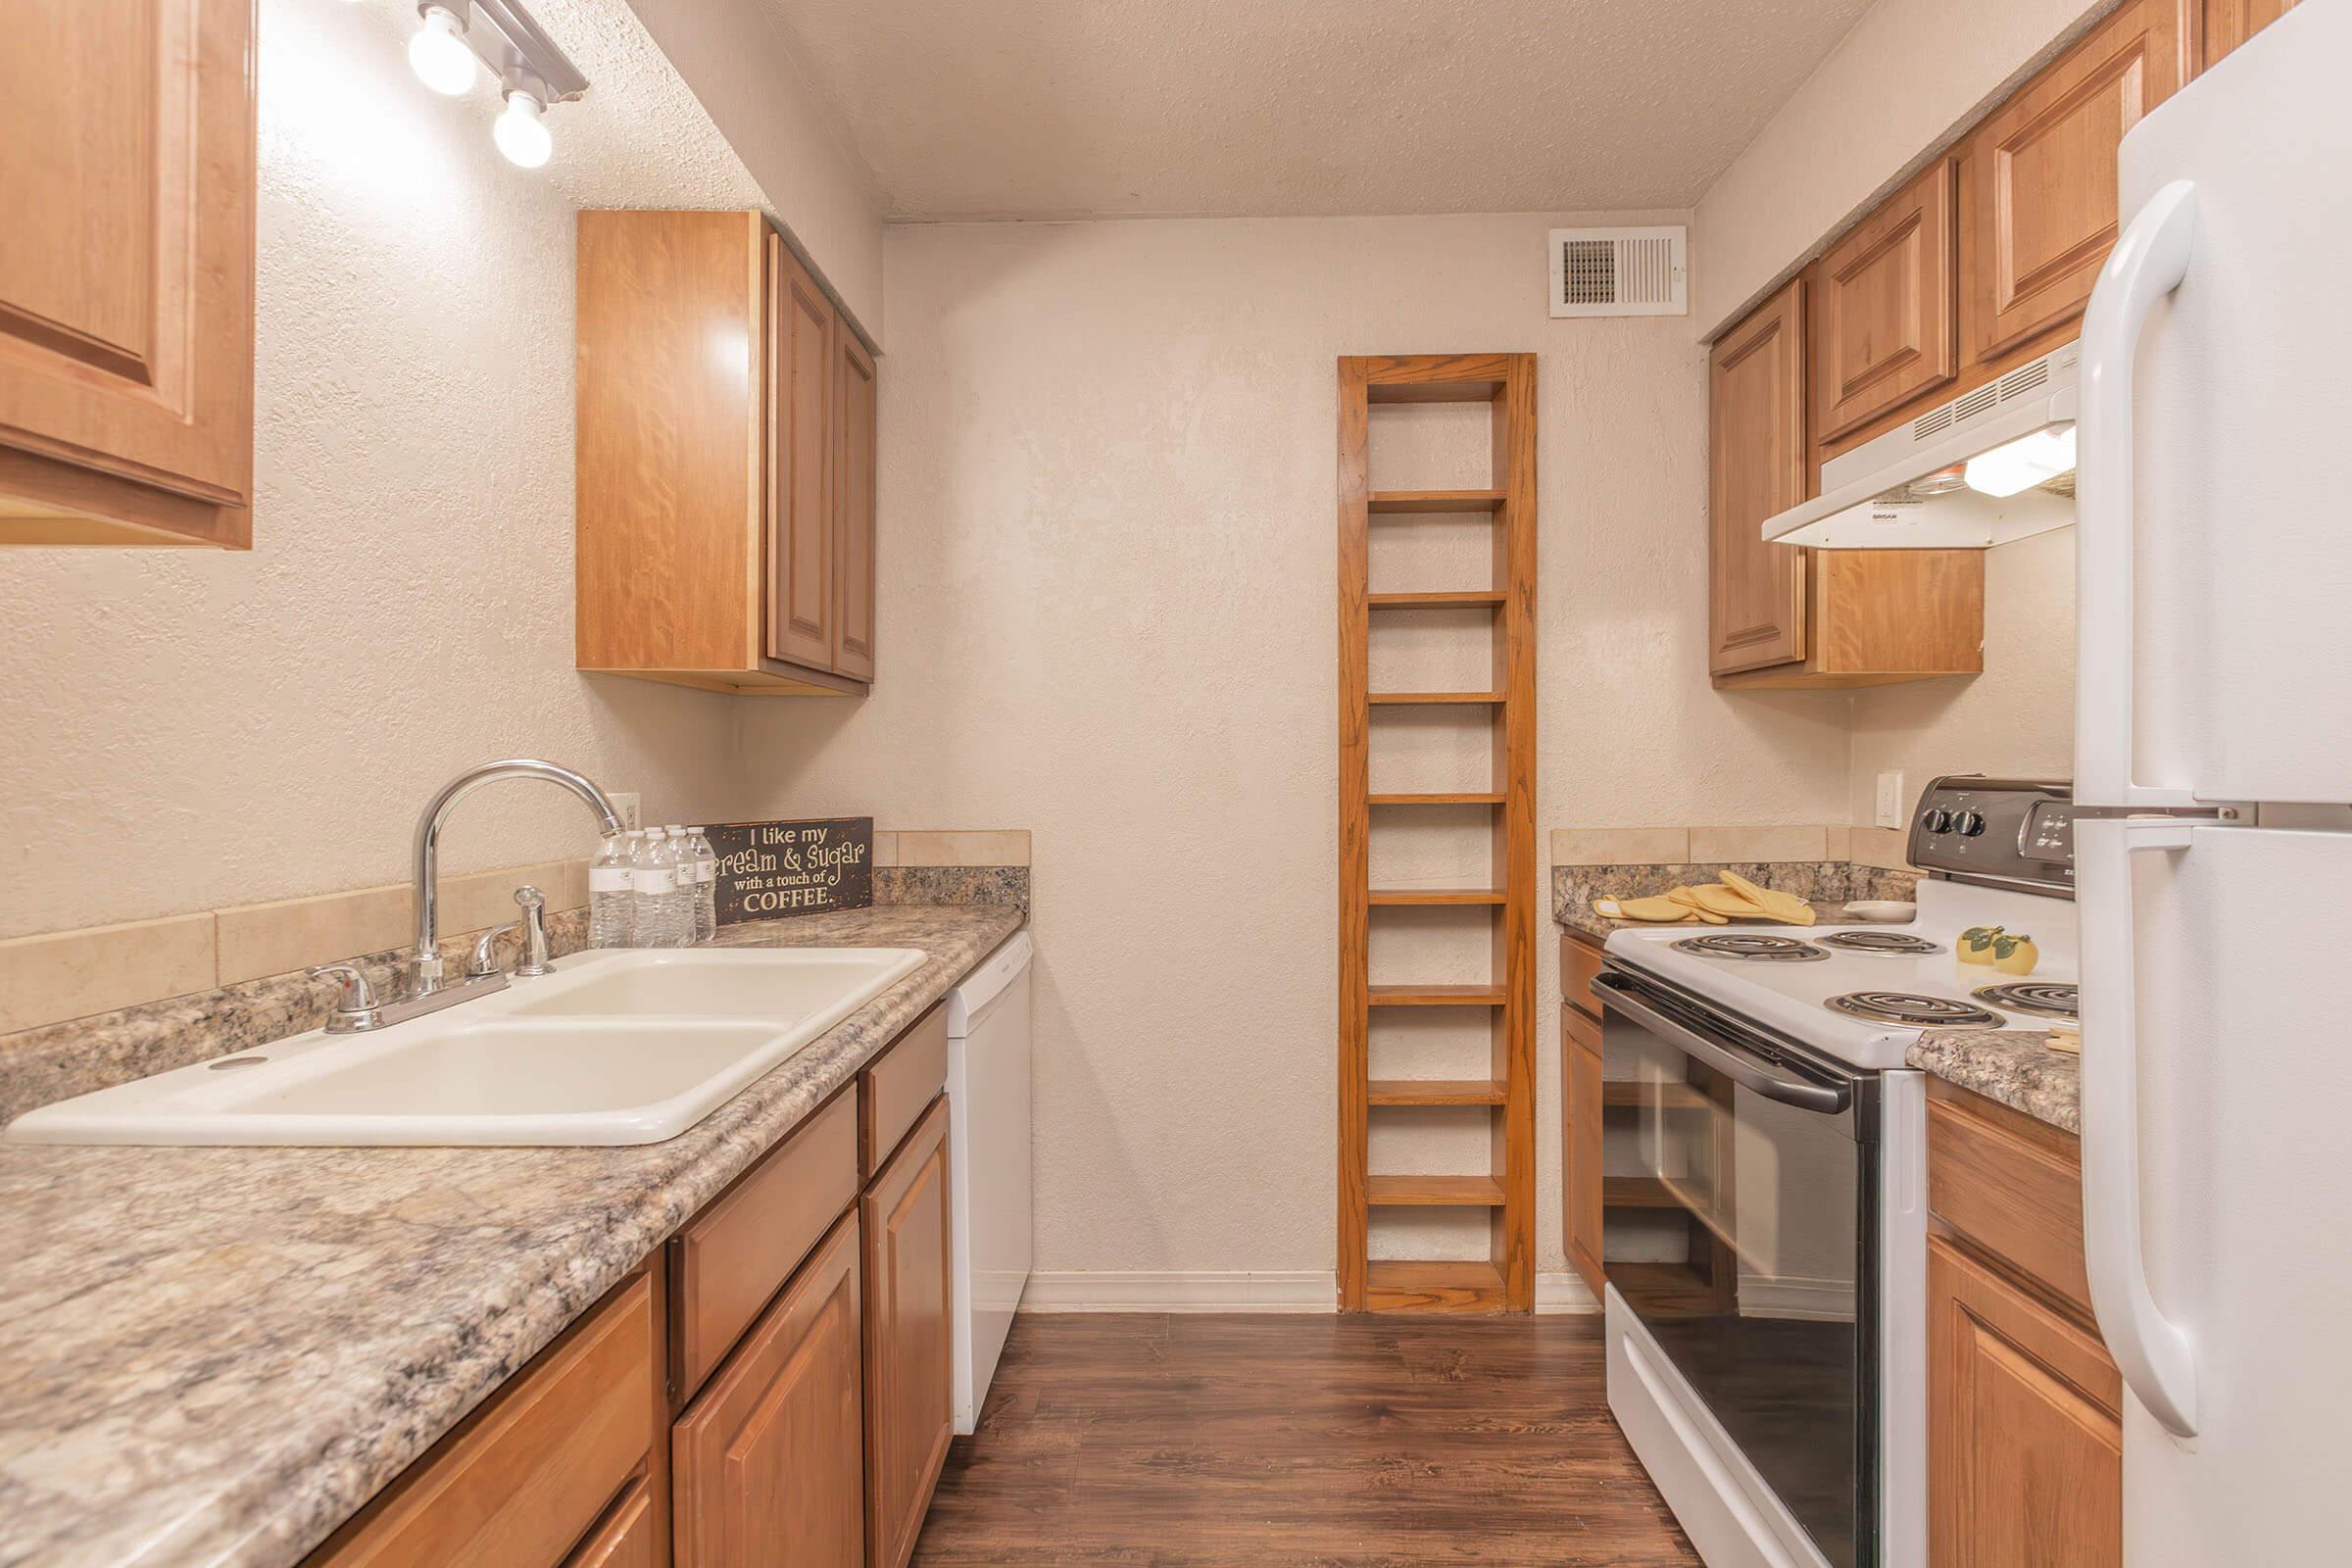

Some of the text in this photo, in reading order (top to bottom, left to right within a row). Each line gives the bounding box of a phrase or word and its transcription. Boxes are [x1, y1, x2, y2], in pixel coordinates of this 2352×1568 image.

[751, 827, 828, 846] I like my
[784, 847, 803, 872] &
[807, 841, 865, 886] Sugar
[734, 869, 828, 891] with a touch of
[743, 887, 834, 912] COFFEE.
